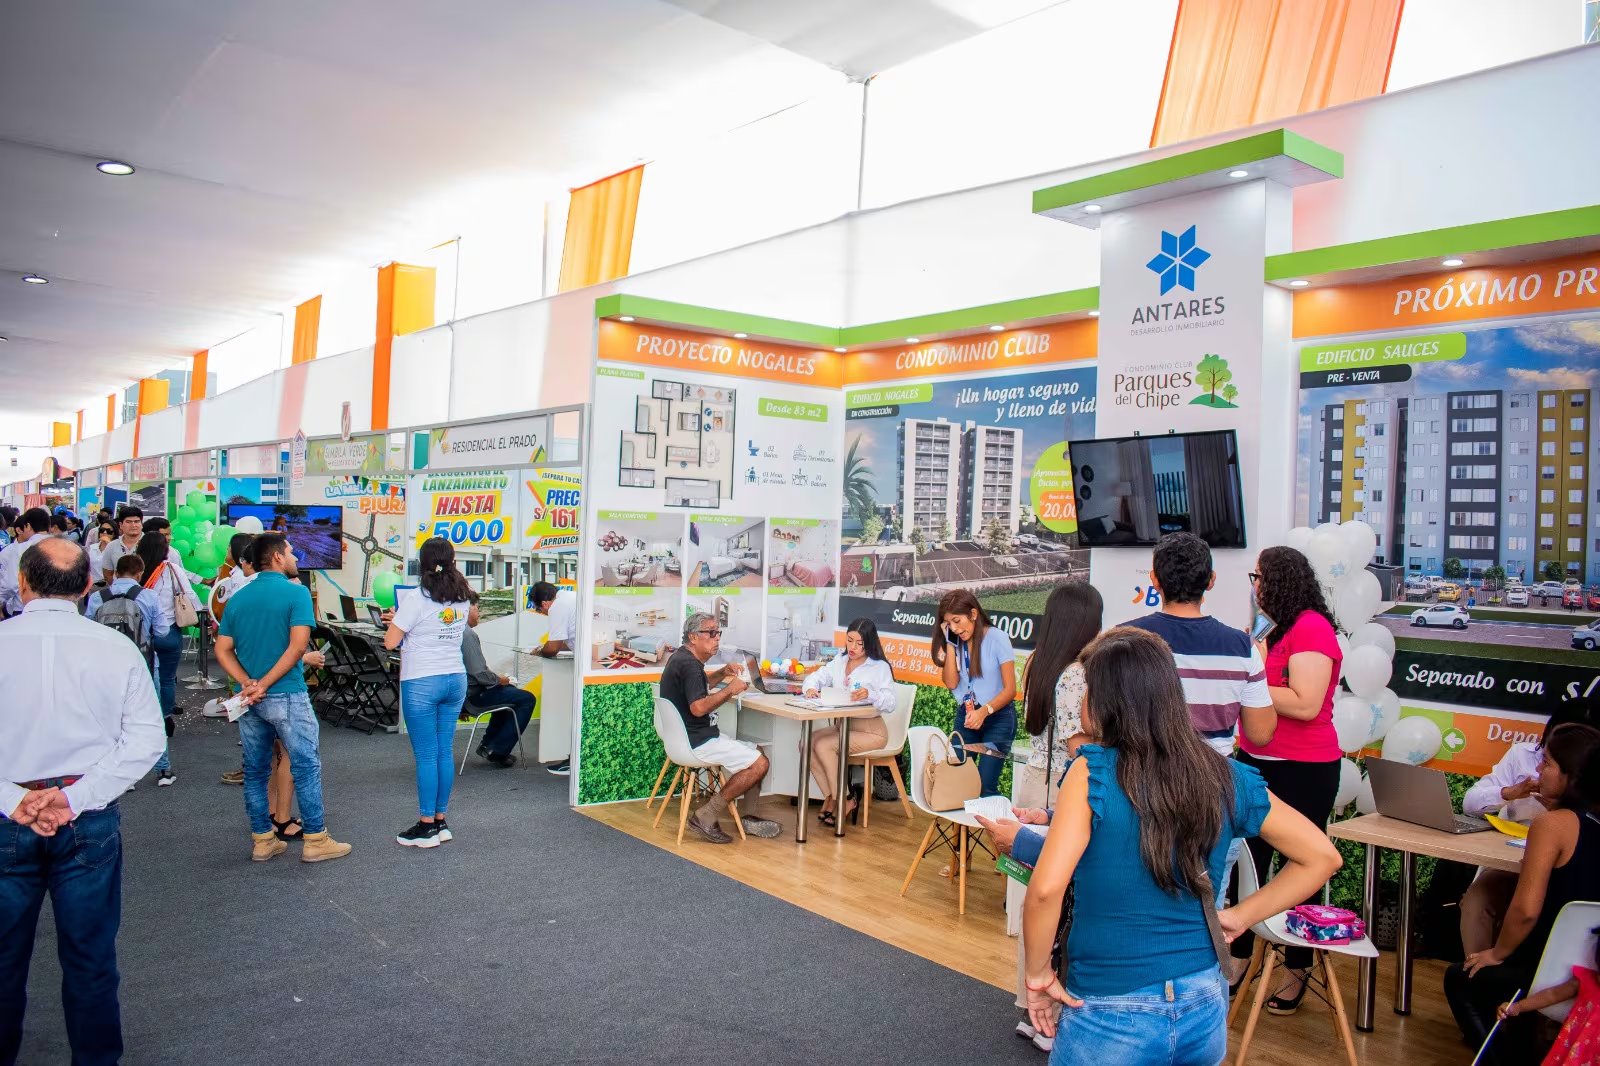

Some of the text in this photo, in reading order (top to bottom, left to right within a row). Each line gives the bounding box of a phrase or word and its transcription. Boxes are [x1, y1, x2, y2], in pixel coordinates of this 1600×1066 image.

[1393, 266, 1600, 316] PRÓXIMO PR
[1131, 296, 1225, 325] ANTARES
[1130, 318, 1225, 336] DESARROLLO INMOBILIARIO
[636, 334, 816, 376] PROYECTO NOGALES
[895, 333, 1050, 371] CONDOMINIO CLUB
[1316, 341, 1440, 366] EDIFICIO SAUCES
[1125, 360, 1193, 373] CONDOMINIO CLUB
[1327, 372, 1344, 384] PRE
[1352, 370, 1380, 382] VENTA
[1114, 371, 1192, 394] Parques
[852, 388, 919, 405] EDIFICIO NOGALES
[955, 382, 1079, 409] ¡Un hogar seguro
[1115, 392, 1180, 410] del Chipe
[766, 402, 822, 417] Desde 83 m2
[994, 396, 1097, 423] y lleno de vid
[452, 434, 537, 454] RESIDENCIAL EL PRADO
[422, 476, 508, 492] LANZAMIENTO
[435, 494, 495, 516] HASTA
[533, 507, 547, 520] S/
[433, 518, 504, 545] 5000
[892, 609, 936, 626] Separalo
[885, 642, 896, 654] de
[897, 643, 904, 655] 3
[888, 659, 907, 670] esde
[909, 659, 922, 671] 83
[1405, 663, 1495, 690] Separalo
[1506, 678, 1545, 696] con
[1487, 723, 1538, 745] Depa
